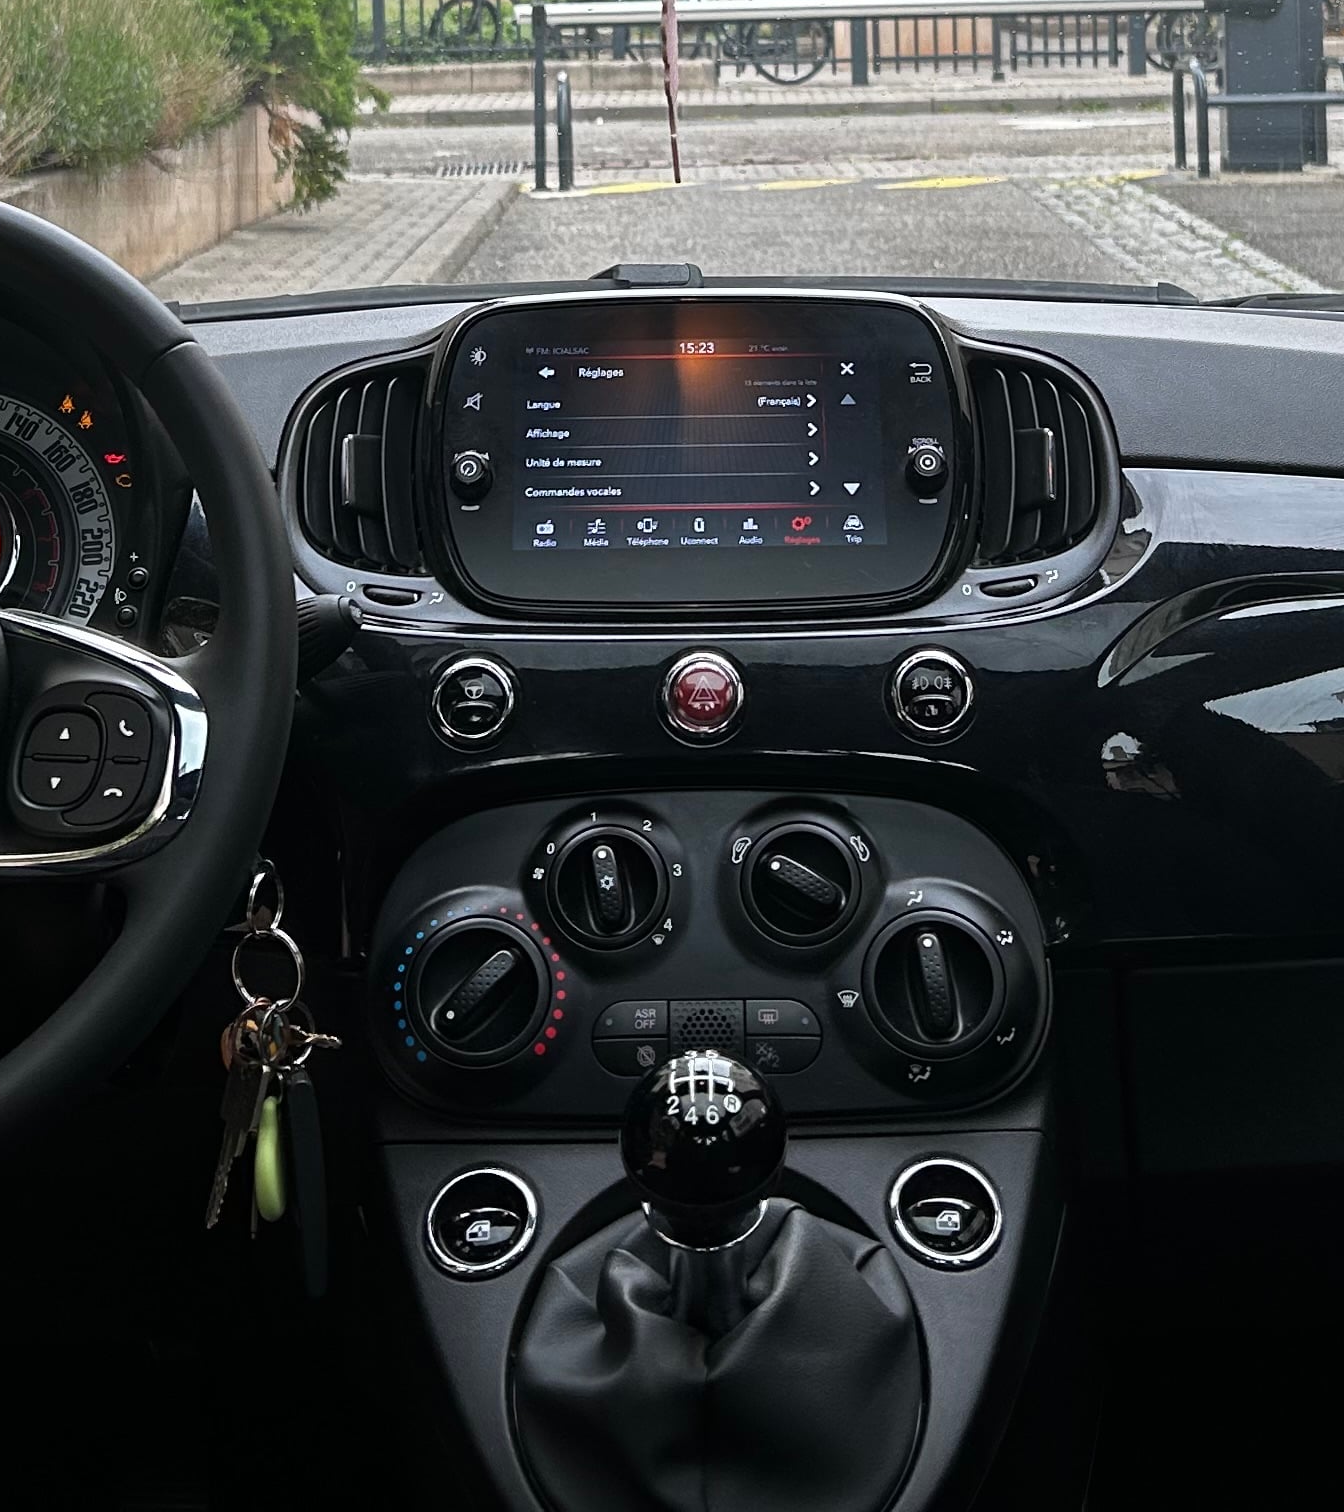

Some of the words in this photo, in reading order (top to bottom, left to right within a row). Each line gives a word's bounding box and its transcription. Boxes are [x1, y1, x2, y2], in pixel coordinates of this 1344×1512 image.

[679, 342, 715, 355] 15:23
[578, 367, 624, 379] Réglages
[910, 376, 932, 384] BACK
[526, 400, 561, 411] Langue
[757, 396, 801, 408] (Français)
[4, 411, 40, 442] 140
[526, 429, 571, 440] Affichage
[42, 437, 77, 473] 160
[525, 458, 551, 467] Unité
[552, 458, 565, 467] de
[567, 459, 602, 467] mesure
[69, 479, 98, 515] 180
[525, 487, 585, 497] Commandes
[587, 486, 622, 496] vocales
[533, 538, 557, 547] Radio
[583, 537, 609, 547] Média
[626, 537, 669, 547] Téléphone
[681, 537, 719, 545] Uconnect
[738, 536, 763, 545] Audio
[845, 534, 862, 545] Trip
[81, 528, 103, 566] 200
[69, 577, 99, 619] 220
[591, 811, 597, 822] 1
[642, 820, 652, 831] 2
[546, 843, 555, 855] 0
[672, 864, 682, 876] 3
[663, 919, 673, 931] 4
[635, 1008, 657, 1019] ASR
[634, 1019, 656, 1030] OFF
[666, 1095, 680, 1116] 2
[684, 1105, 699, 1125] 4
[705, 1104, 720, 1125] 6
